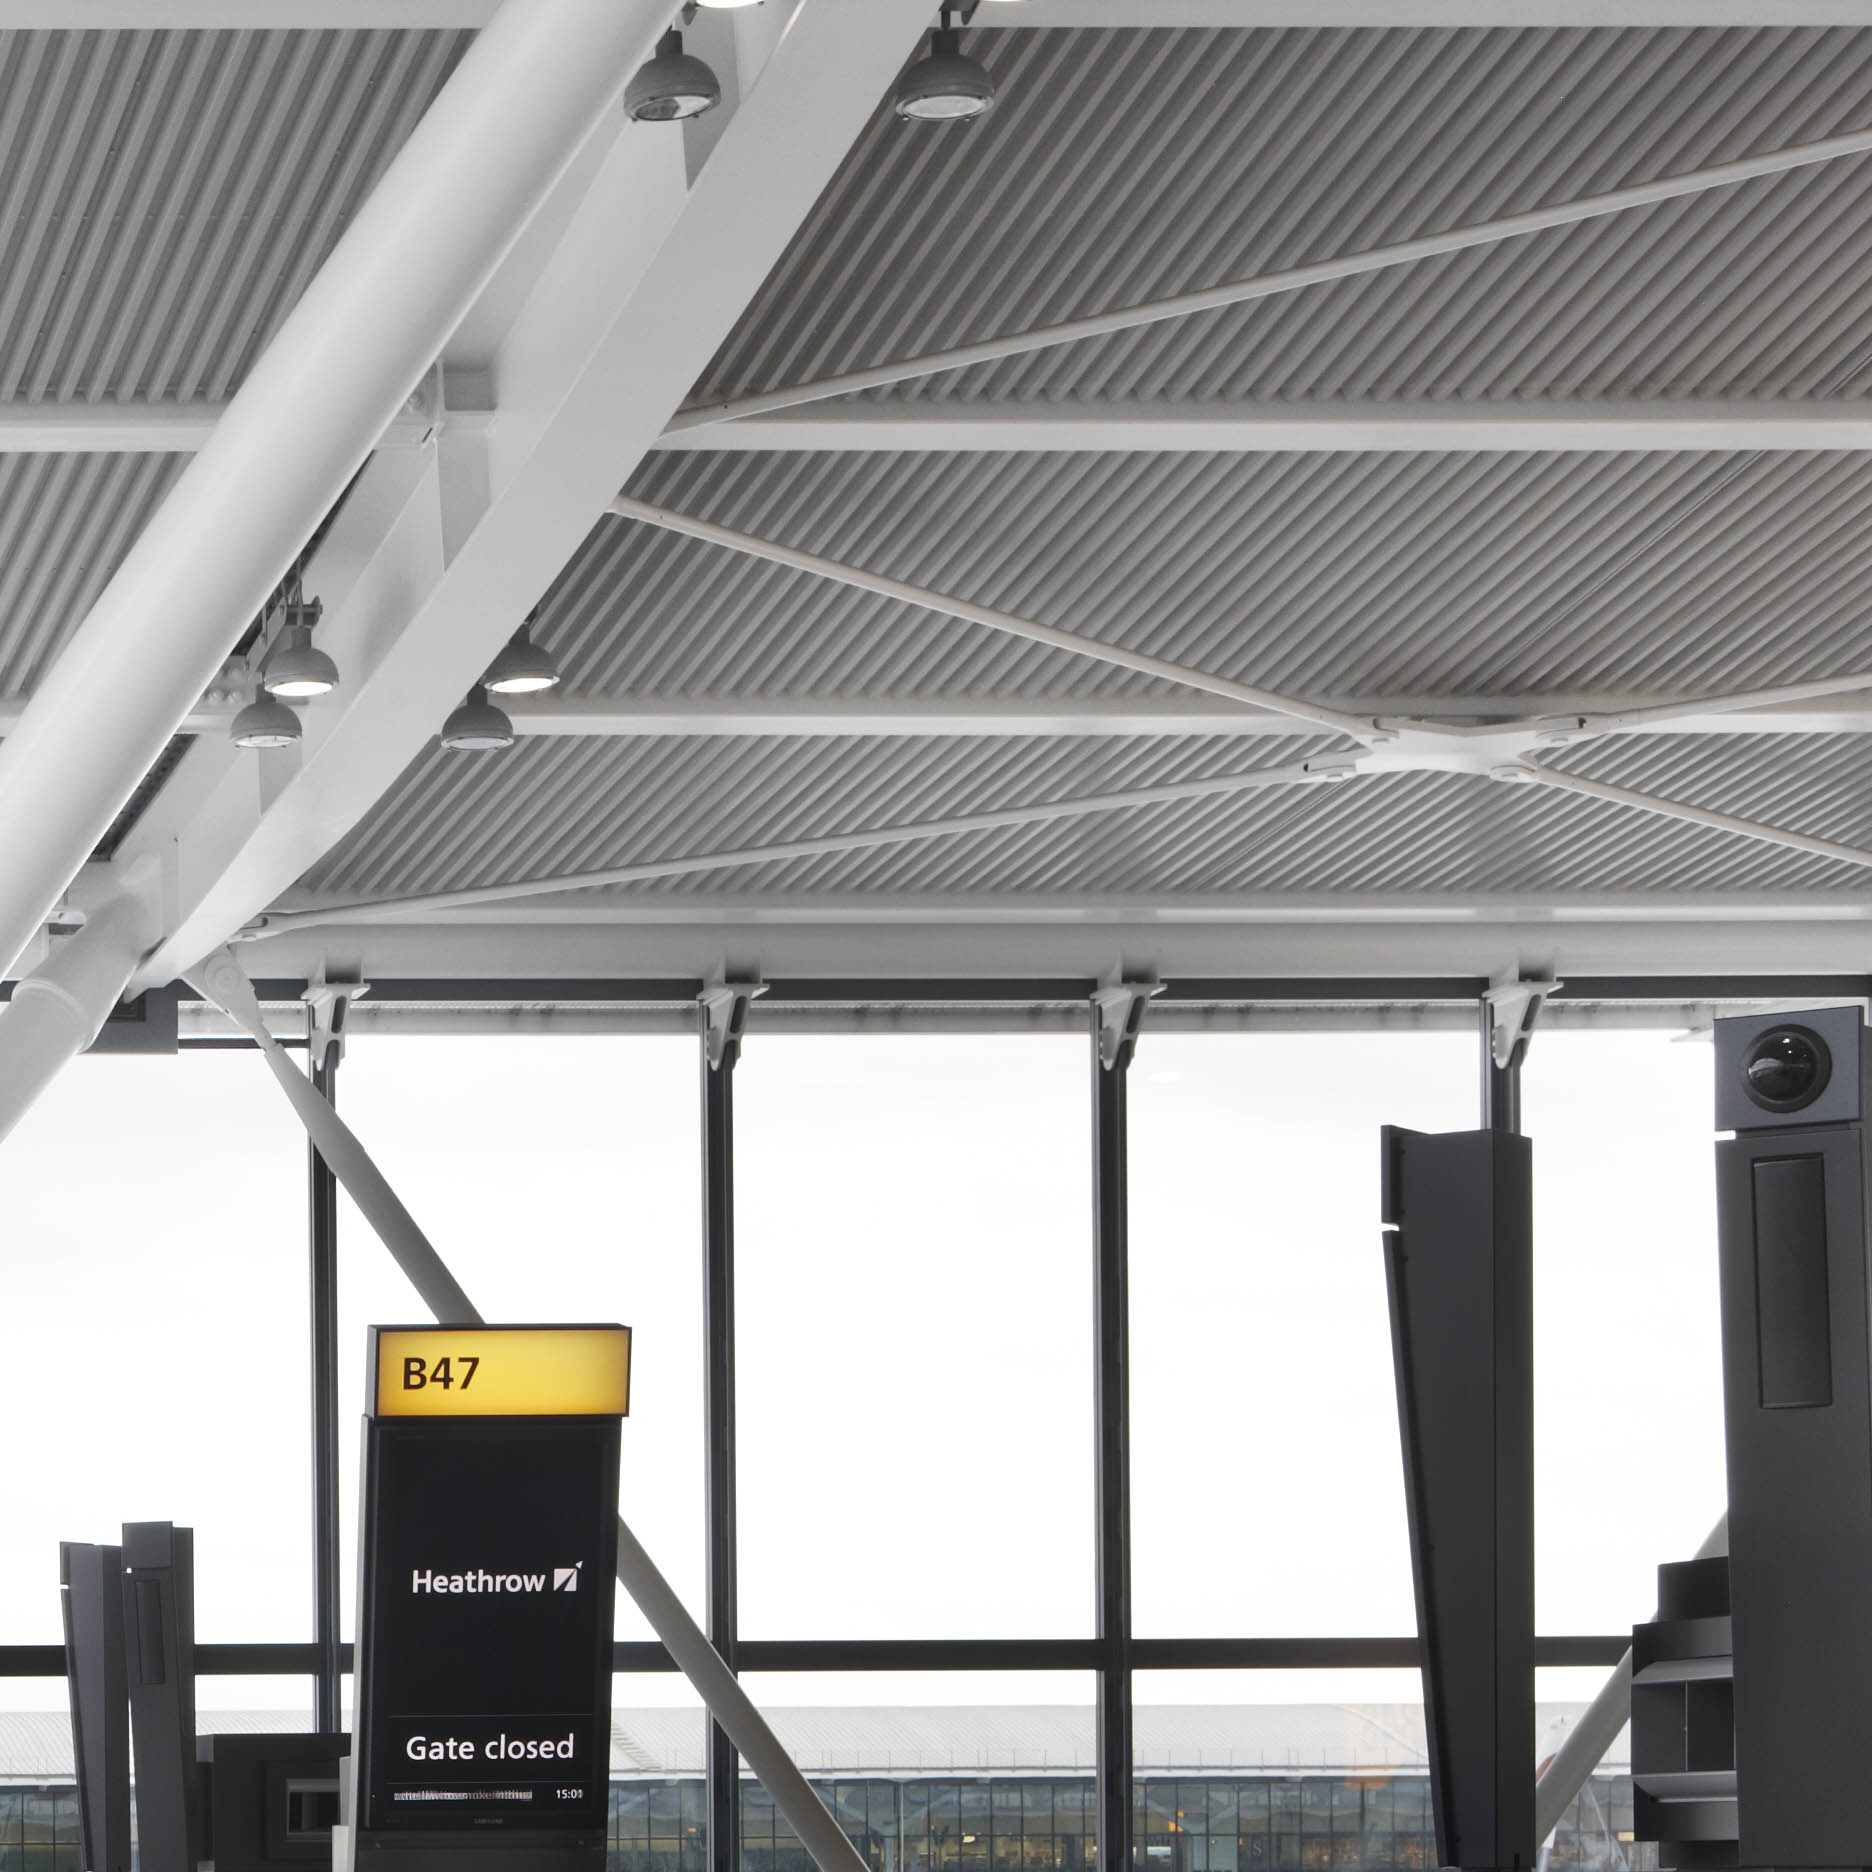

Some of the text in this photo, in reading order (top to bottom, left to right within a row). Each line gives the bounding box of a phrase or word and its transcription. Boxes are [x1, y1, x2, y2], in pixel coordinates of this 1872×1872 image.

[403, 1356, 480, 1391] B47
[412, 1568, 546, 1594] Heathrow
[406, 1732, 574, 1762] Gate closed
